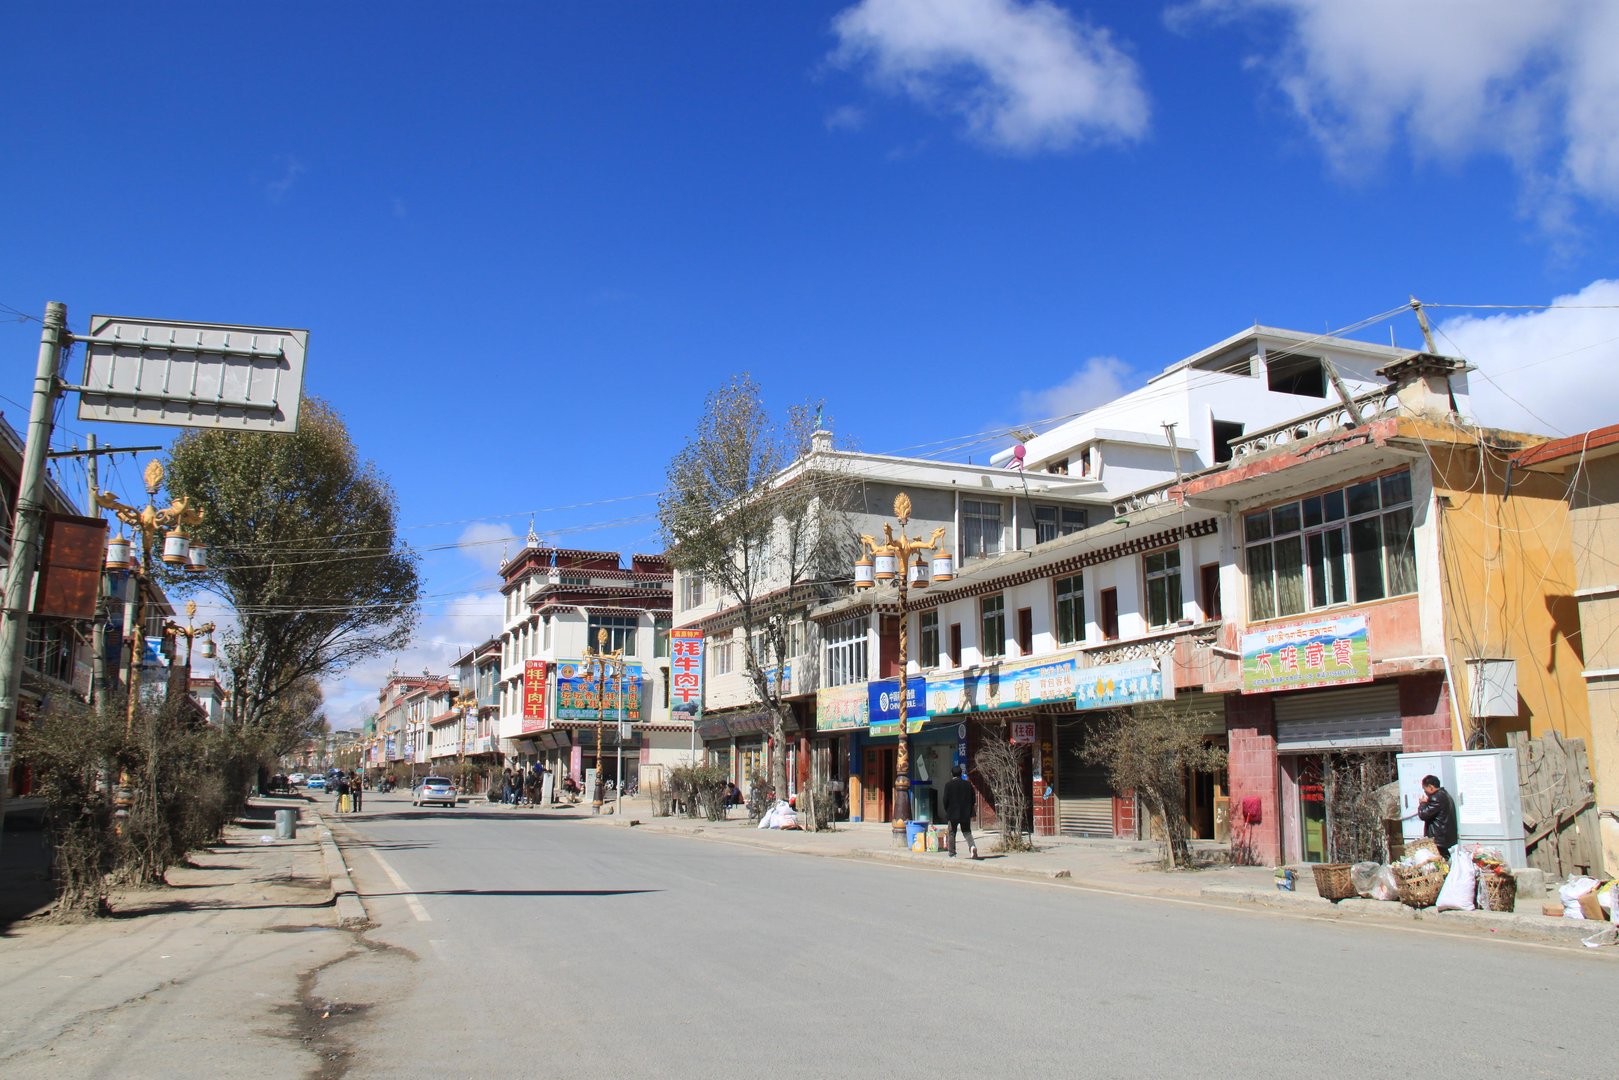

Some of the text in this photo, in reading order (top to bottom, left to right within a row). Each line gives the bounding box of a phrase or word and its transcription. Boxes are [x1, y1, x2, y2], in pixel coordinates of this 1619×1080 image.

[673, 640, 700, 703] 牦牛肉干
[1256, 638, 1353, 679] 木雅藏餐
[526, 669, 544, 715] 牦牛肉干
[889, 689, 915, 702] 中国通信
[1014, 724, 1035, 737] 住宿
